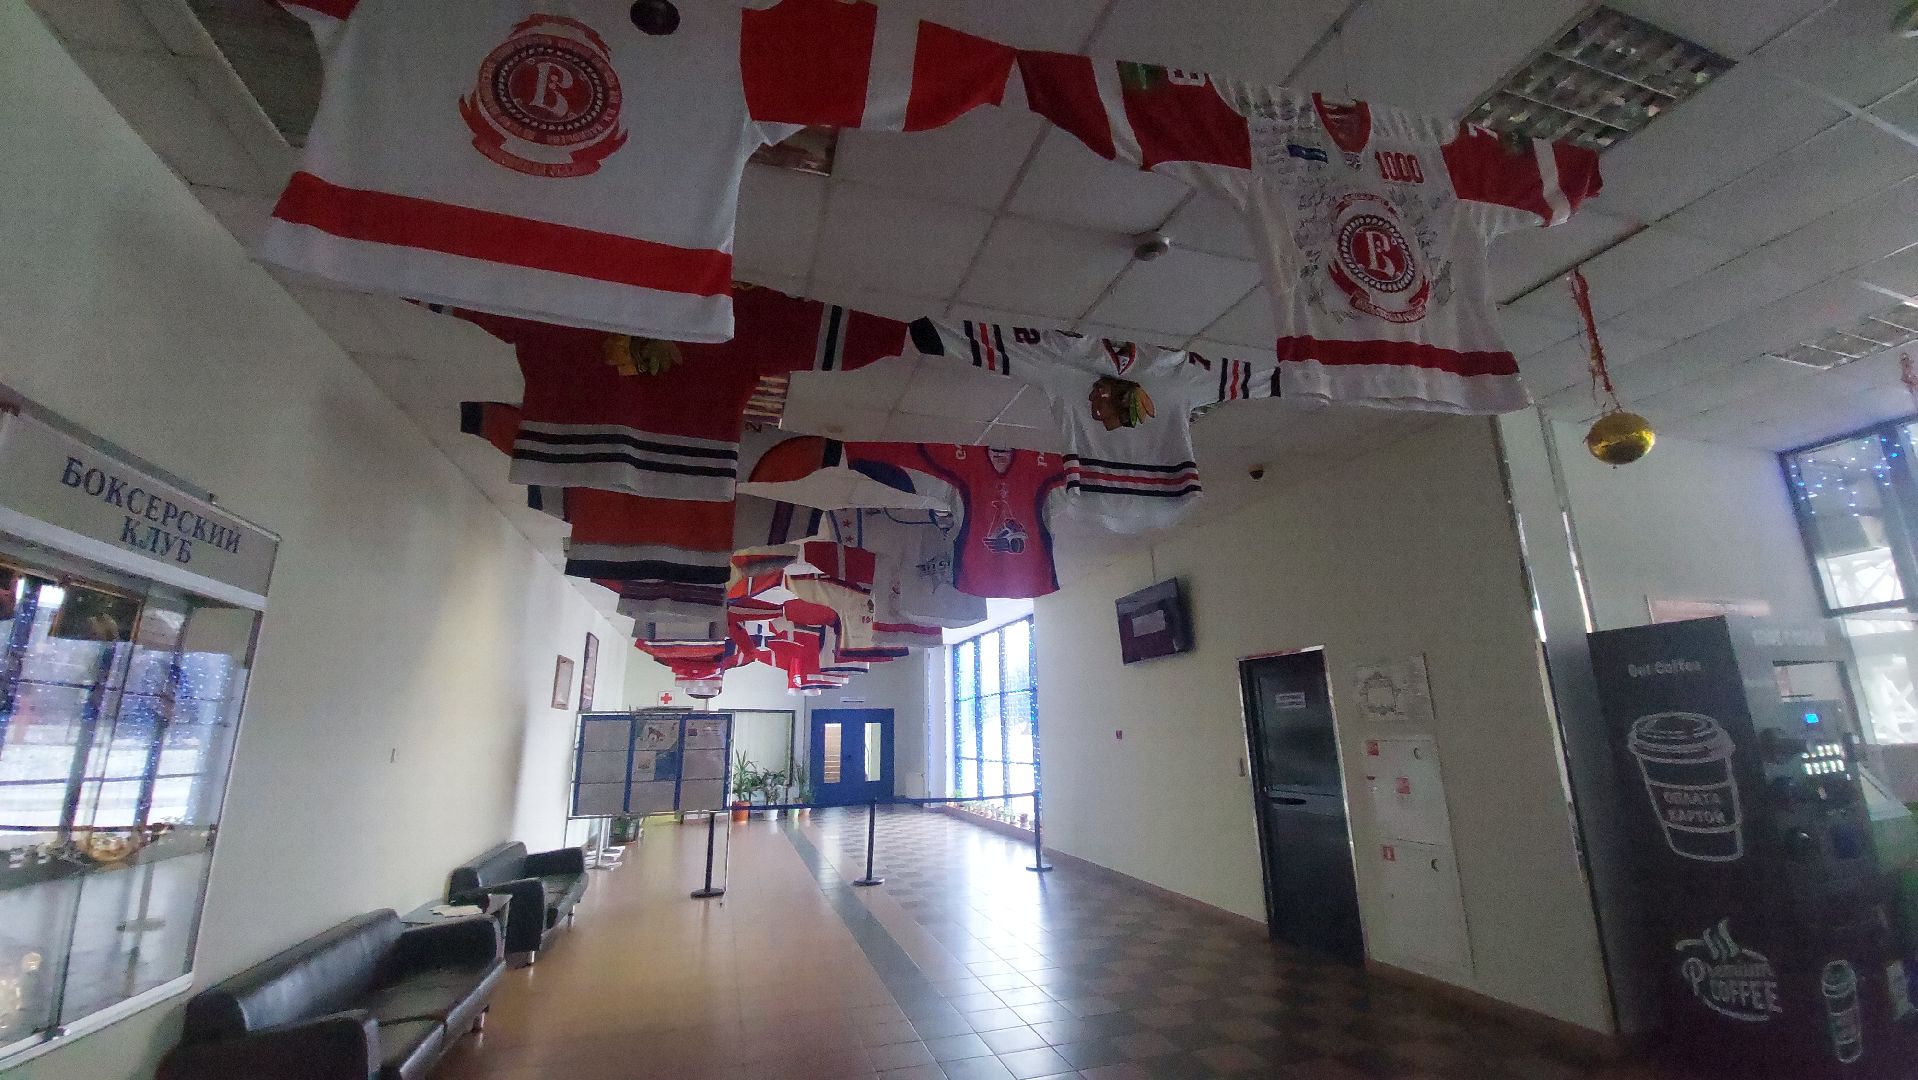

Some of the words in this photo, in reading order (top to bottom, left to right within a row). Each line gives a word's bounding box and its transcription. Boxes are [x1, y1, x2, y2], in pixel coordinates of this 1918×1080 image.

[1375, 151, 1424, 183] 1000
[60, 456, 242, 554] БОКСЕРСКИЙ
[120, 515, 192, 564] КЛУБ
[1709, 979, 1784, 1014] COFFEE
